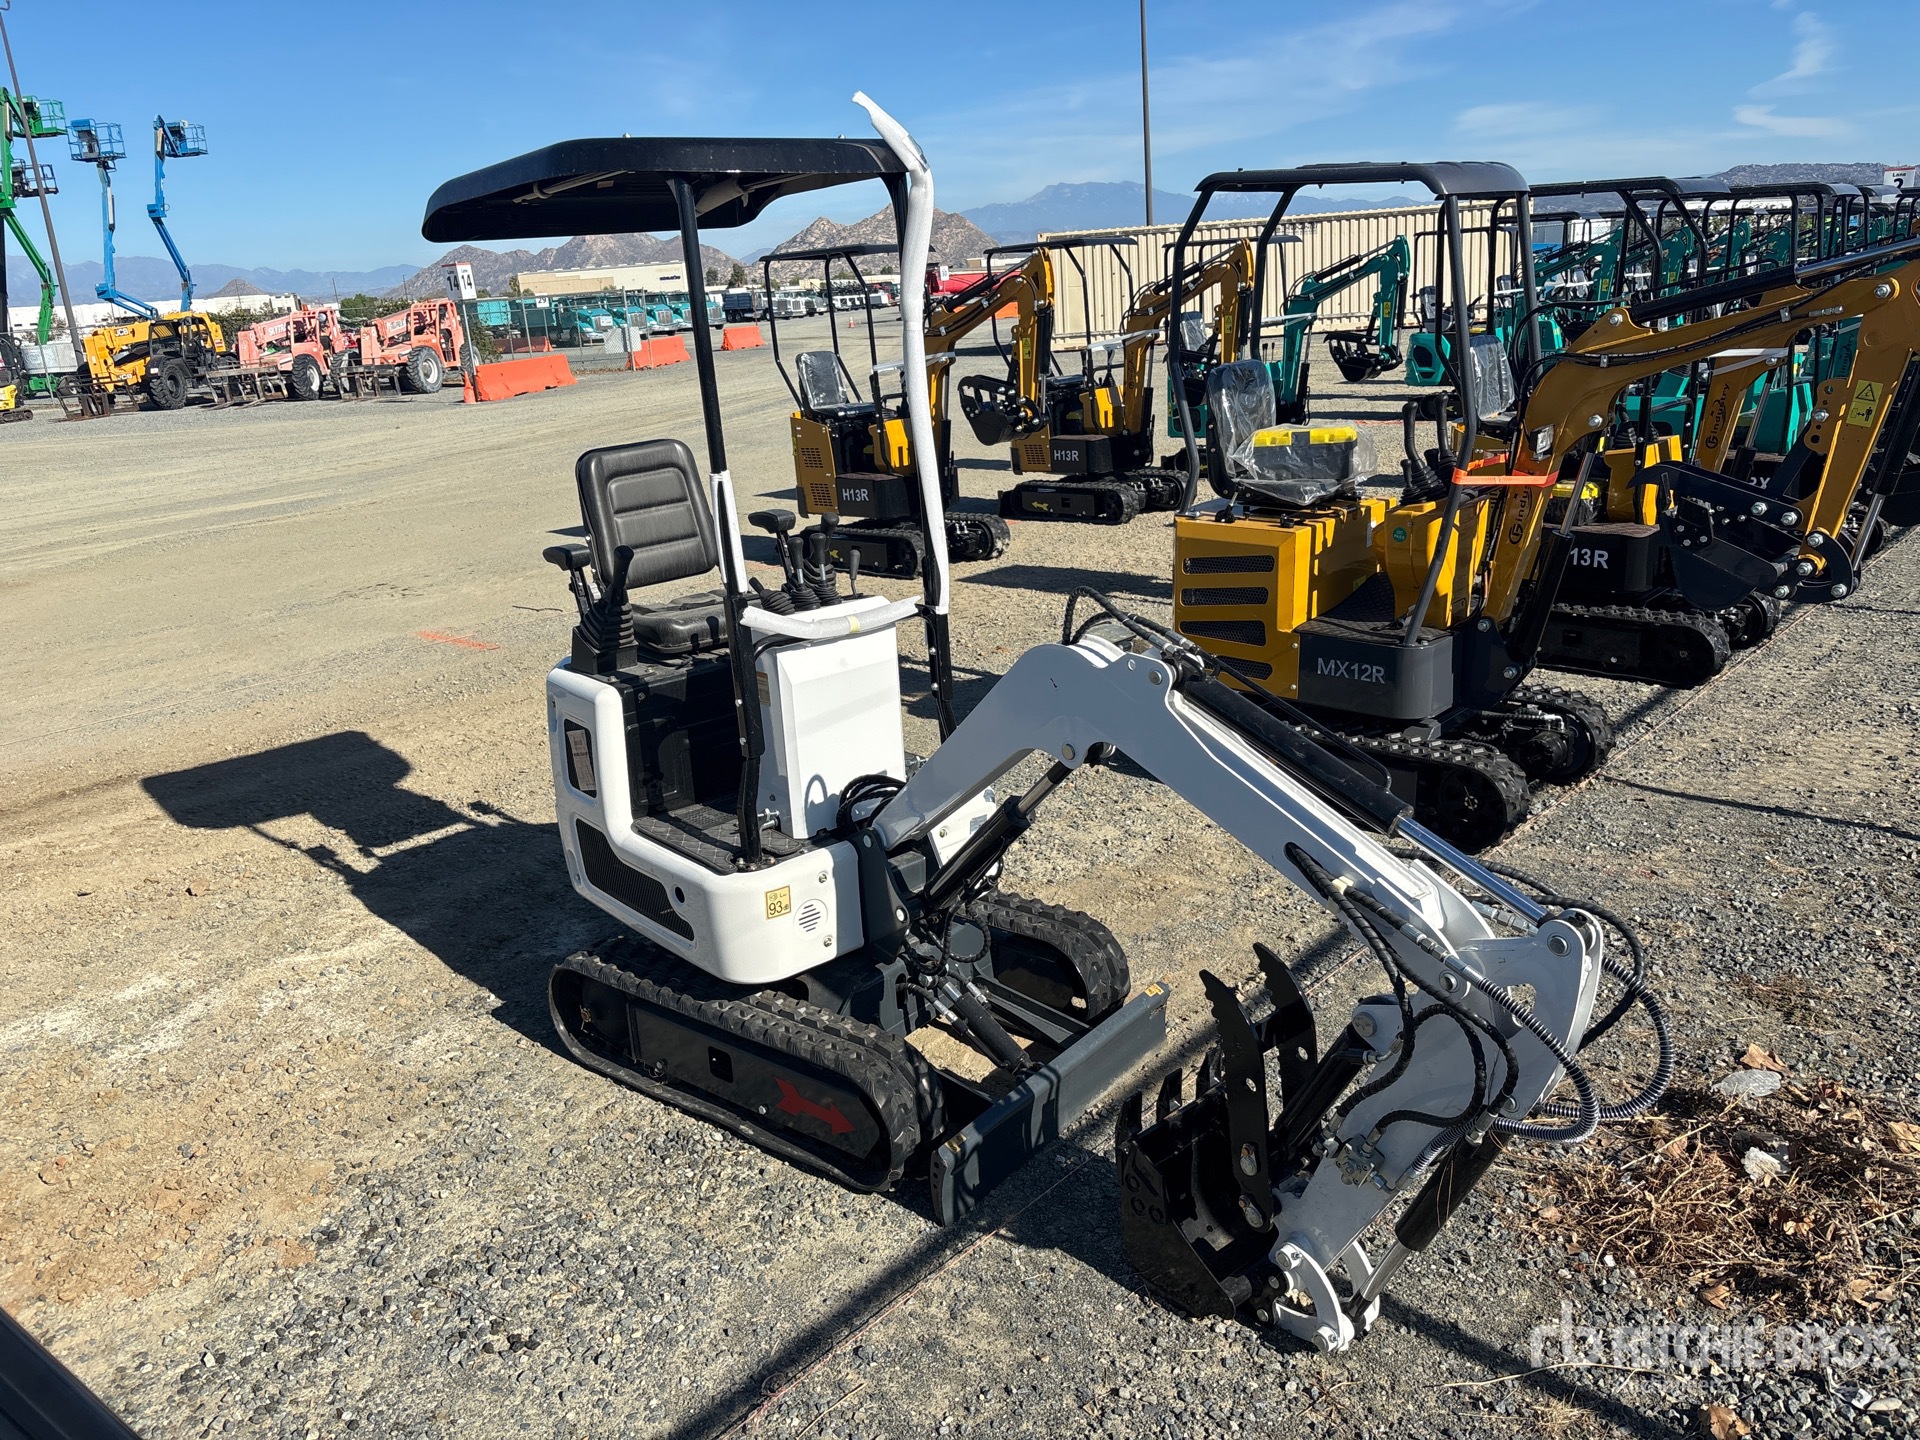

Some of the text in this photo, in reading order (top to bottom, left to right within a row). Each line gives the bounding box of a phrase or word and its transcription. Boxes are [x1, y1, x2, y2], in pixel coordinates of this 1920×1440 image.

[446, 275, 460, 291] 14
[461, 274, 472, 290] 14
[115, 327, 129, 337] JCB
[1054, 449, 1079, 462] H13R
[842, 488, 869, 502] H13R
[1317, 657, 1385, 684] MX12R
[768, 900, 783, 915] 93
